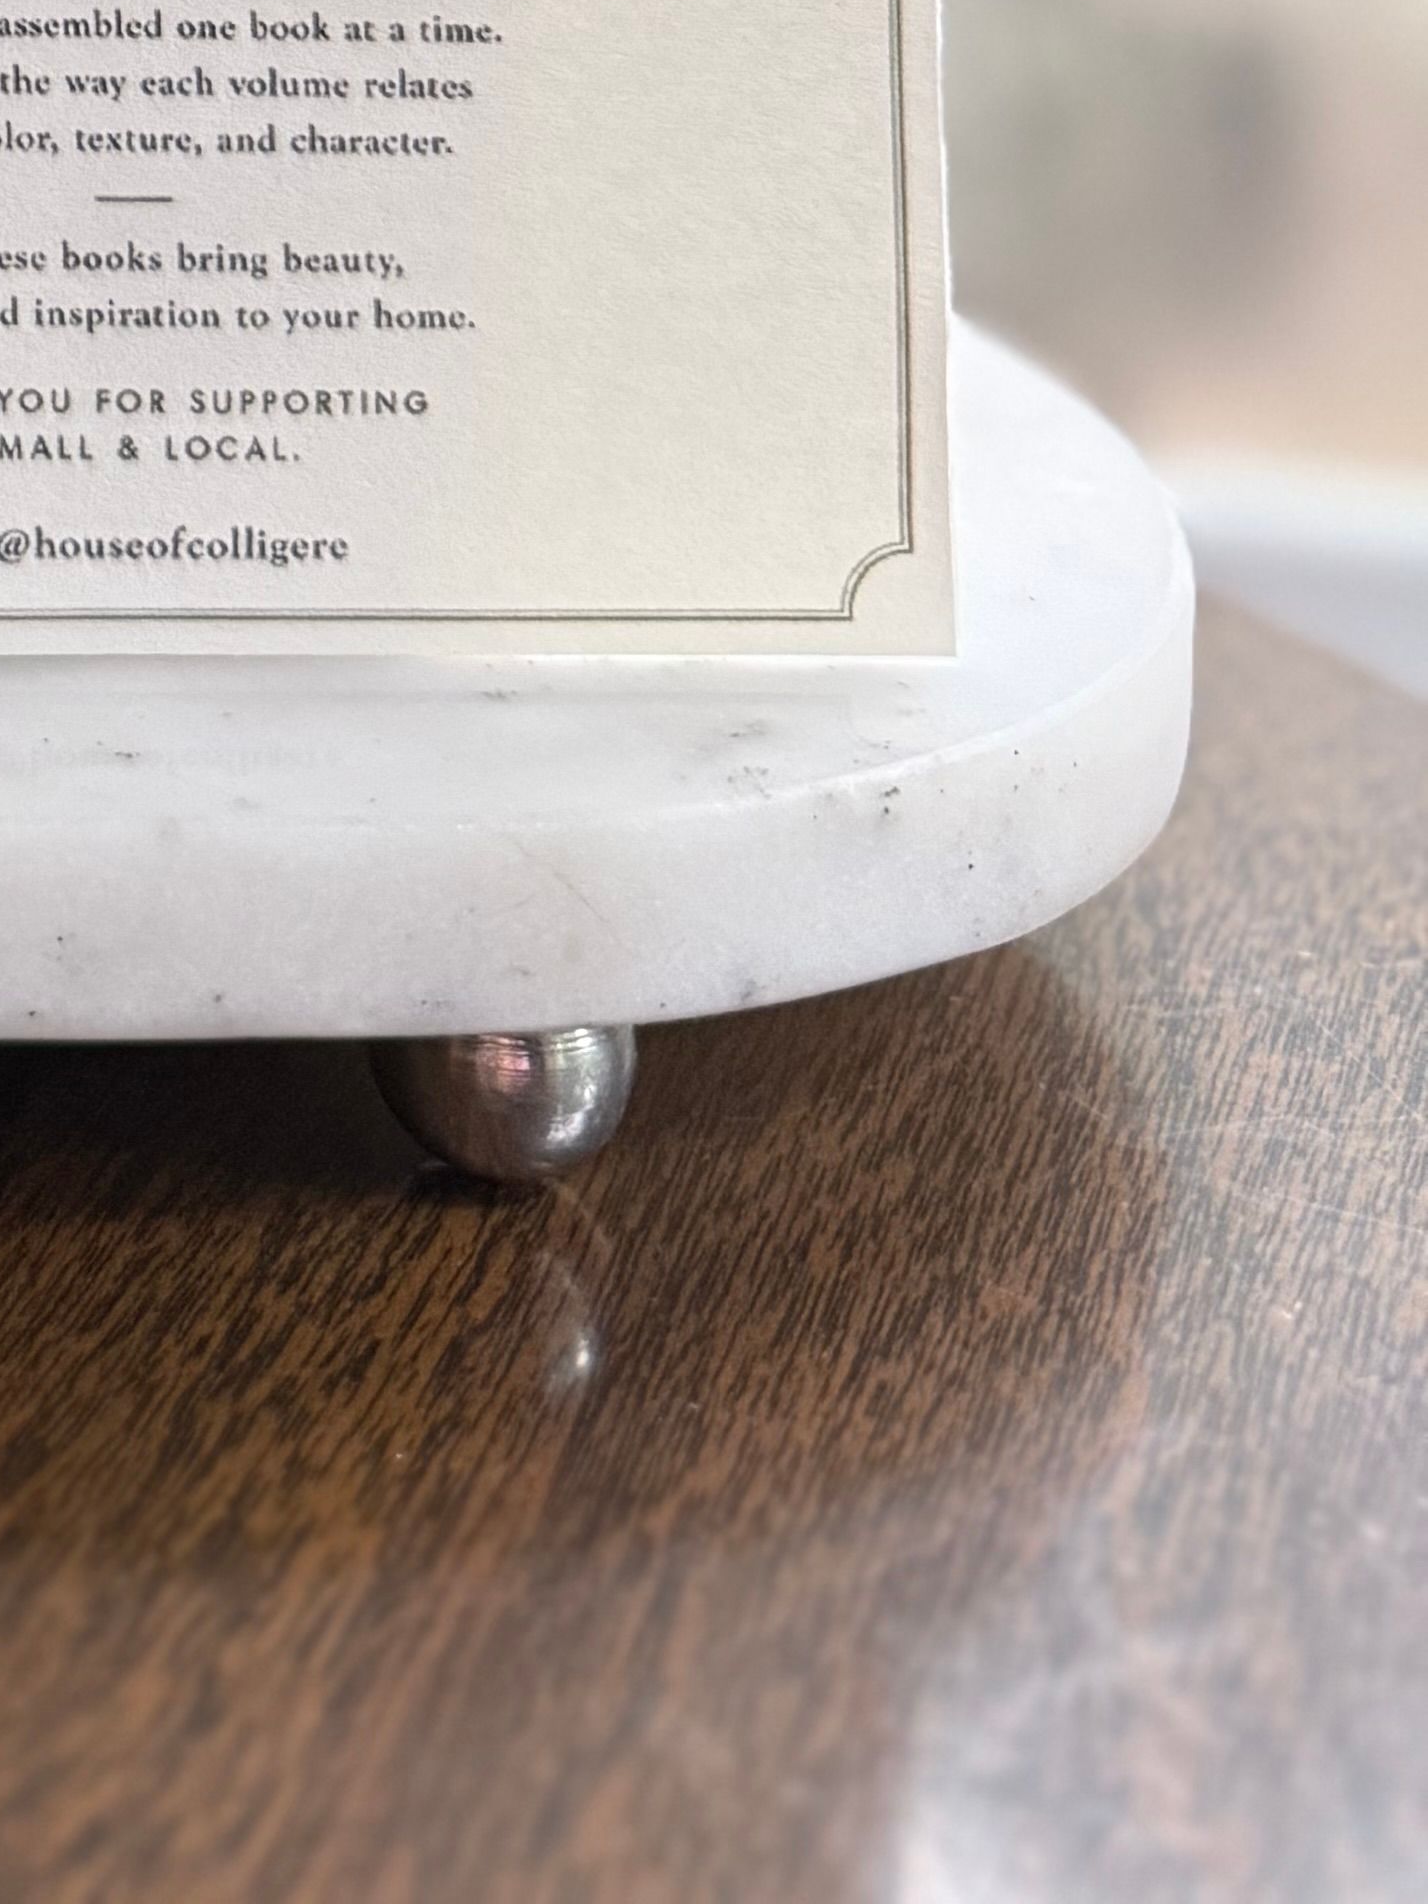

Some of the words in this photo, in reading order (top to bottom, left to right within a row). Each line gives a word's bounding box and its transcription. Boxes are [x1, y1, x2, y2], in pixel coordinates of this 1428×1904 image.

[174, 18, 238, 43] one
[248, 7, 333, 44] book
[342, 14, 380, 45] at
[387, 19, 409, 45] a
[418, 13, 504, 47] time.
[63, 73, 128, 105] way
[137, 64, 218, 100] each
[226, 65, 352, 101] volume
[363, 66, 476, 102] relates
[73, 126, 204, 162] texture,
[215, 121, 279, 158] and
[288, 121, 456, 159] character.
[59, 237, 164, 274] books
[175, 239, 270, 283] bring
[281, 240, 407, 283] beauty,
[33, 296, 224, 338] inspiration
[233, 302, 271, 332] to
[281, 307, 362, 339] your
[371, 296, 477, 333] home.
[94, 386, 168, 418] FOR
[188, 387, 431, 419] SUPPORTING
[115, 433, 141, 464] &
[163, 433, 302, 466] LOCAL.
